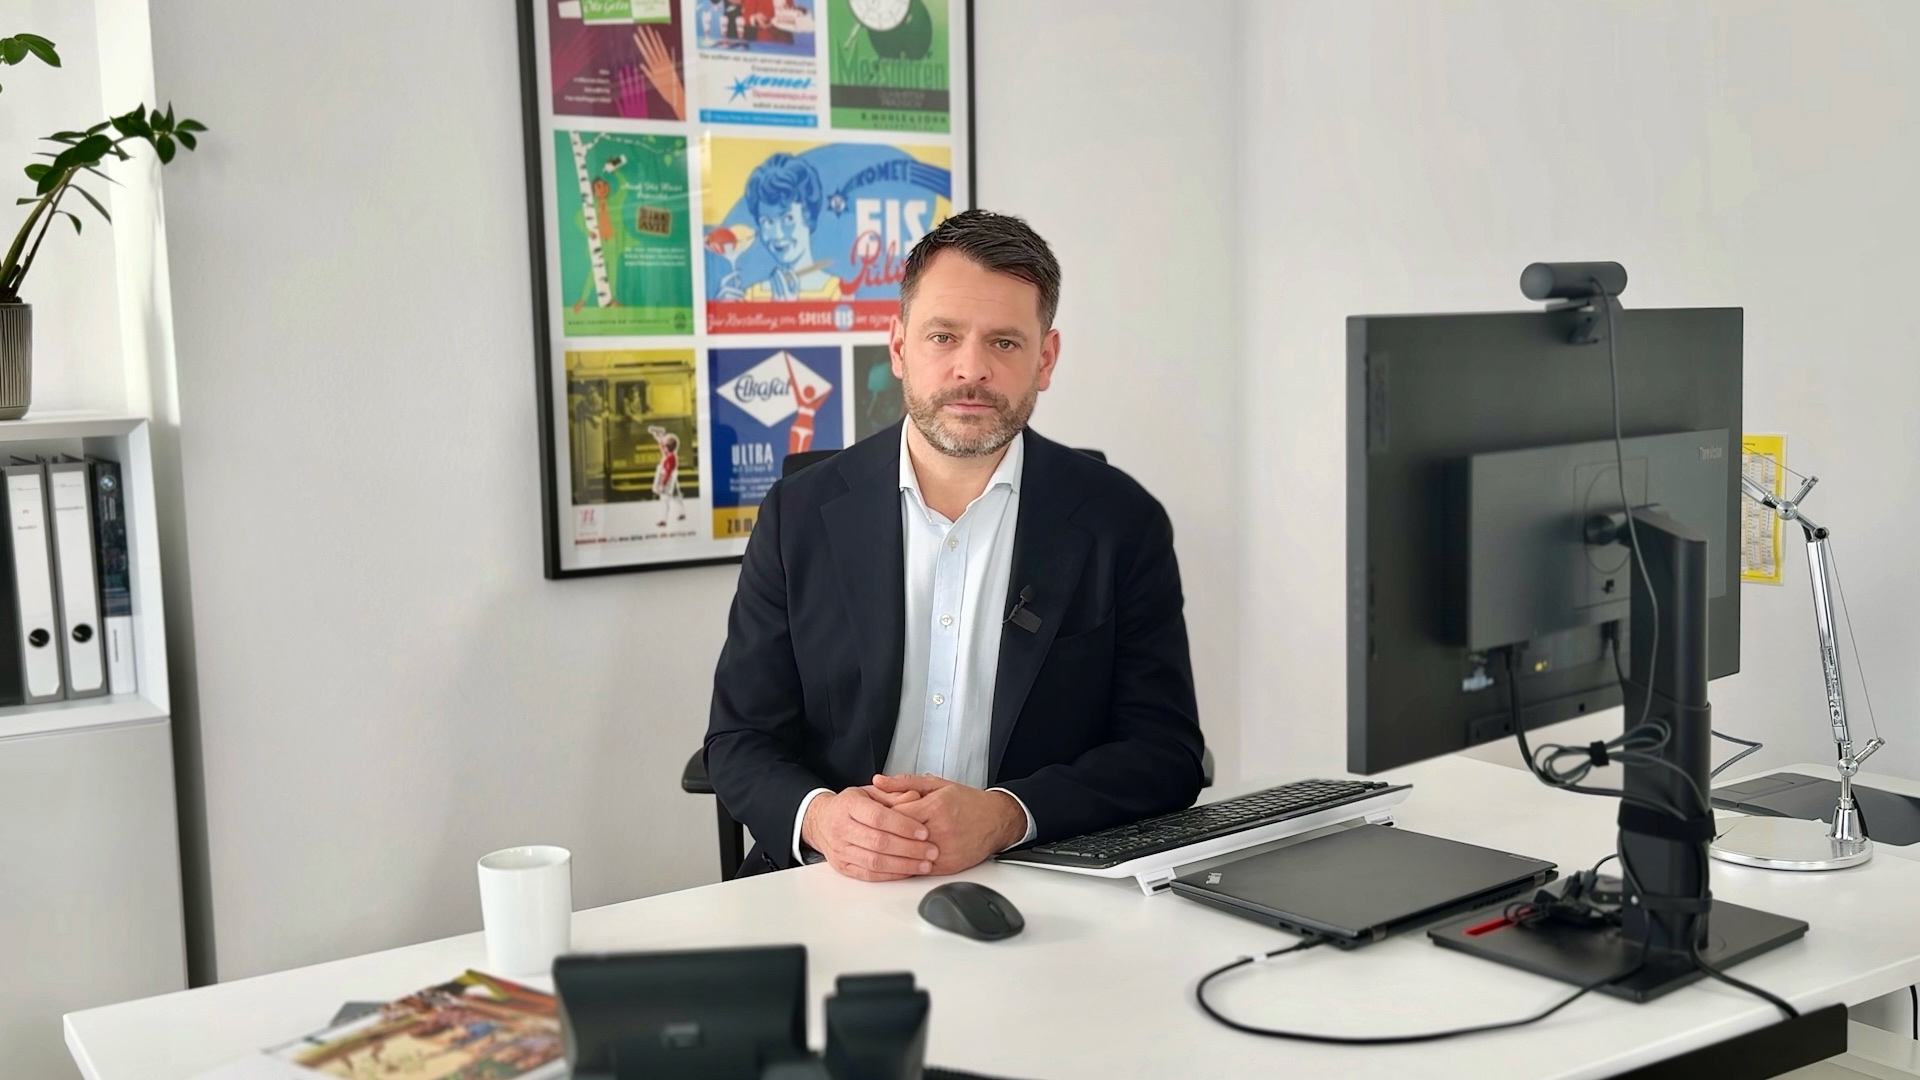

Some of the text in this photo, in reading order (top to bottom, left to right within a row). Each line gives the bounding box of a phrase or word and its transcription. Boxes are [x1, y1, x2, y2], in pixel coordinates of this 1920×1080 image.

[854, 160, 908, 187] KOMET
[856, 198, 927, 257] EIS
[798, 310, 832, 326] SPEISE
[731, 442, 774, 466] ULTRA
